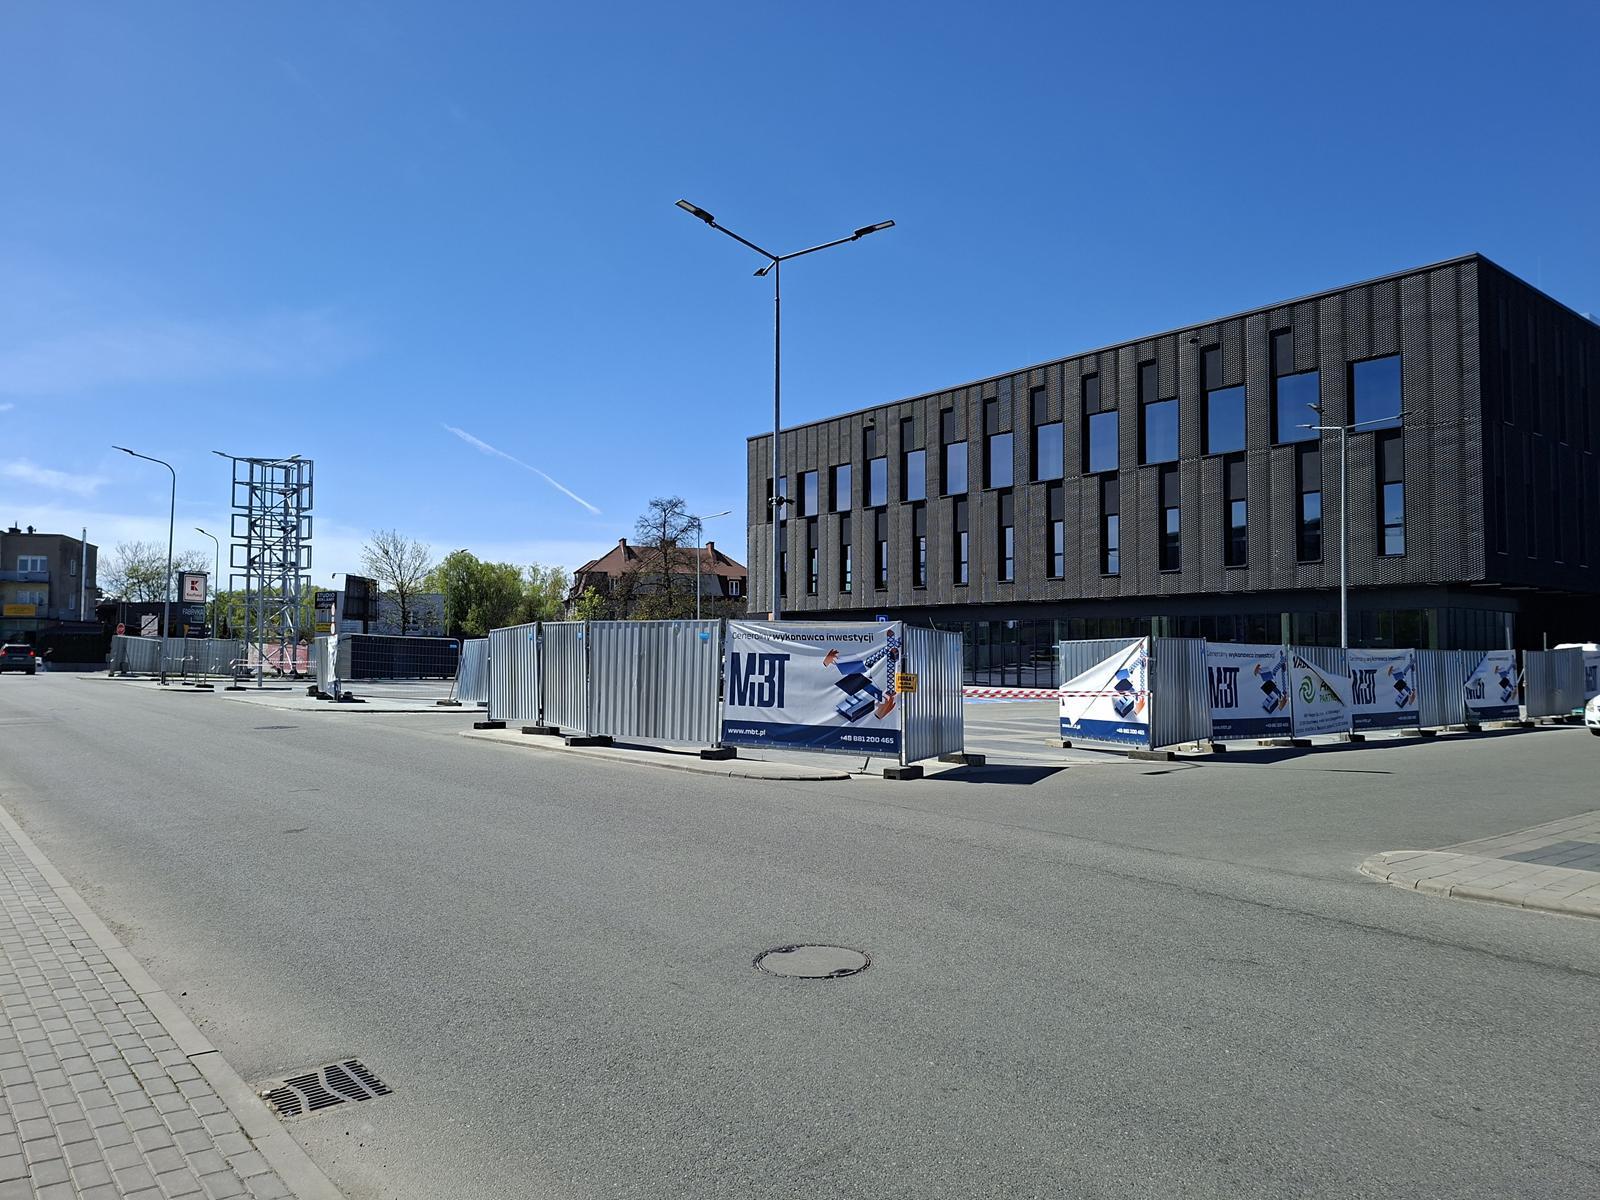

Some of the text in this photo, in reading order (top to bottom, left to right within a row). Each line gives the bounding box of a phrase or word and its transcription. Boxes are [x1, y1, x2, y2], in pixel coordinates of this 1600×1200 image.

[772, 632, 825, 643] wykonawca
[826, 632, 874, 643] inwestycji
[729, 653, 791, 708] MBT
[1208, 666, 1240, 708] MBT
[1351, 669, 1378, 705] MBT
[728, 728, 766, 737] www.mbt.pl
